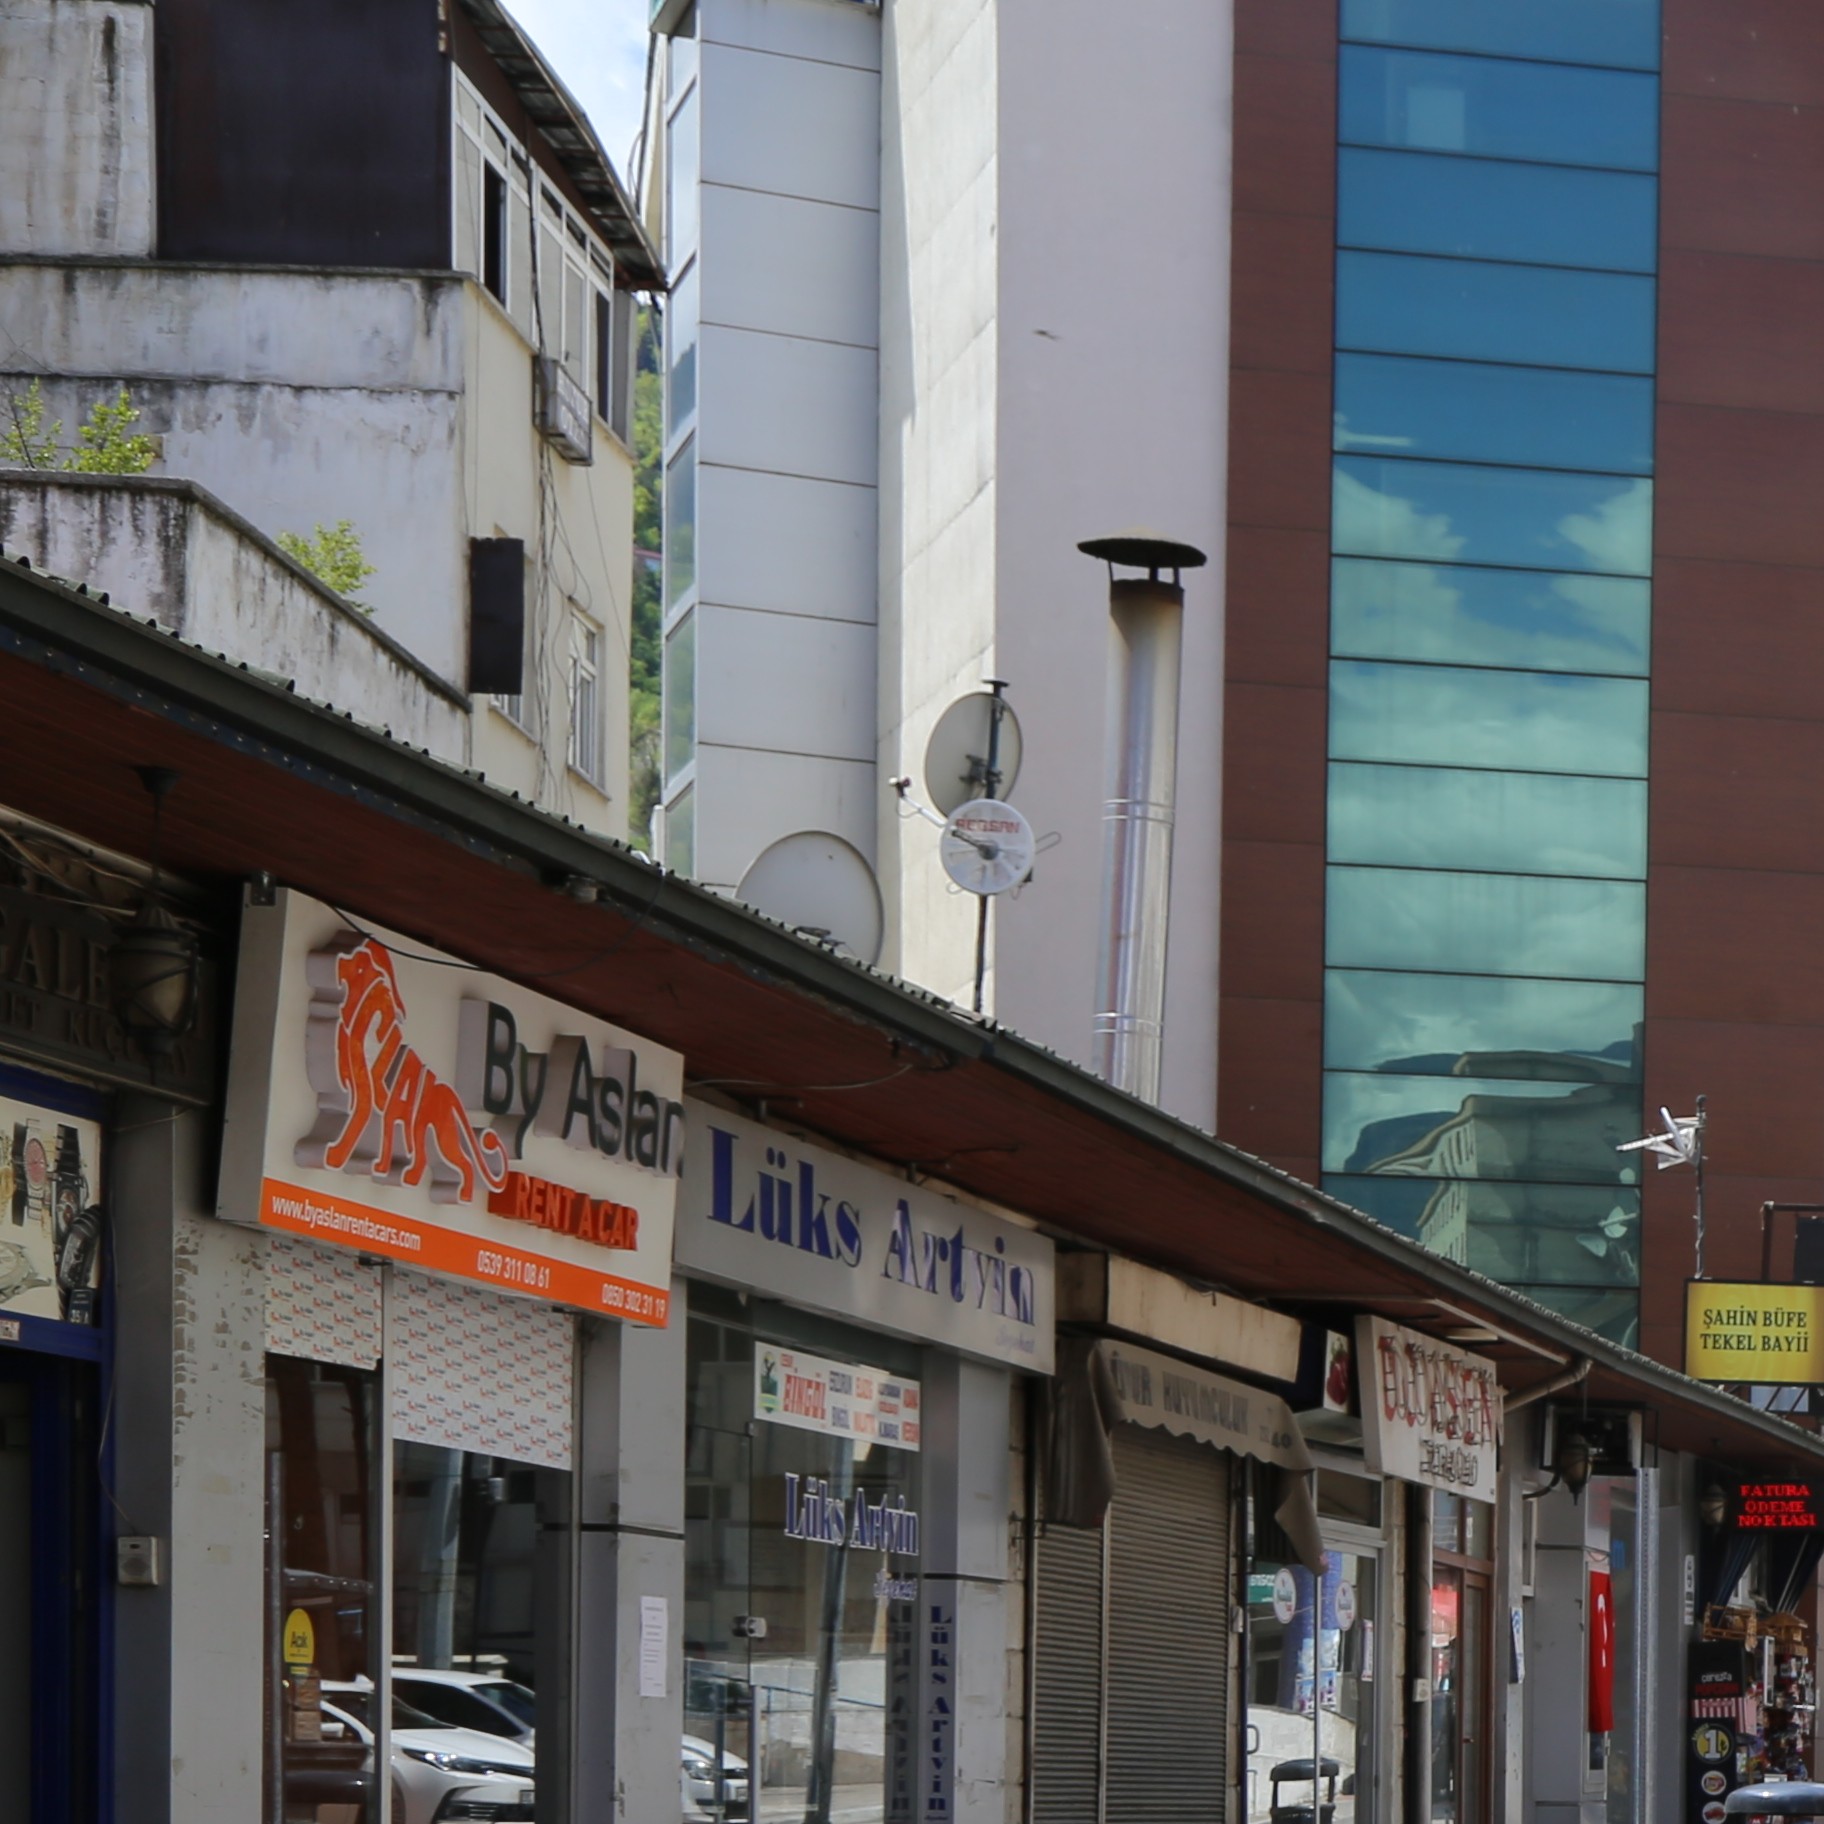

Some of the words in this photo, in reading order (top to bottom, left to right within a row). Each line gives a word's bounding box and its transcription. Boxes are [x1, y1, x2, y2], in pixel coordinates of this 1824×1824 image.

[485, 1000, 547, 1160] By
[562, 1033, 684, 1178] Aslan
[272, 1193, 422, 1253] www.byaslanrentacars.com
[514, 1174, 574, 1231] RENT
[575, 1194, 593, 1239] A
[598, 1201, 639, 1251] CAR
[707, 1124, 862, 1268] Lüks
[883, 1196, 1035, 1327] Artvin
[476, 1249, 502, 1278] 0539
[503, 1254, 523, 1281] 311
[538, 1264, 550, 1289] 61
[642, 1292, 654, 1316] 31
[1703, 1305, 1758, 1330] ŞAHİN
[1762, 1307, 1807, 1328] BÜFE
[1700, 1333, 1757, 1351] TEKEL
[1761, 1332, 1809, 1353] BAYİİ
[784, 1472, 846, 1546] Lüks
[849, 1487, 919, 1556] Artvin
[1738, 1514, 1817, 1527] NOKTASI
[1739, 1484, 1811, 1497] FATURA
[930, 1606, 952, 1684] Lüks
[928, 1697, 950, 1811] Artvin
